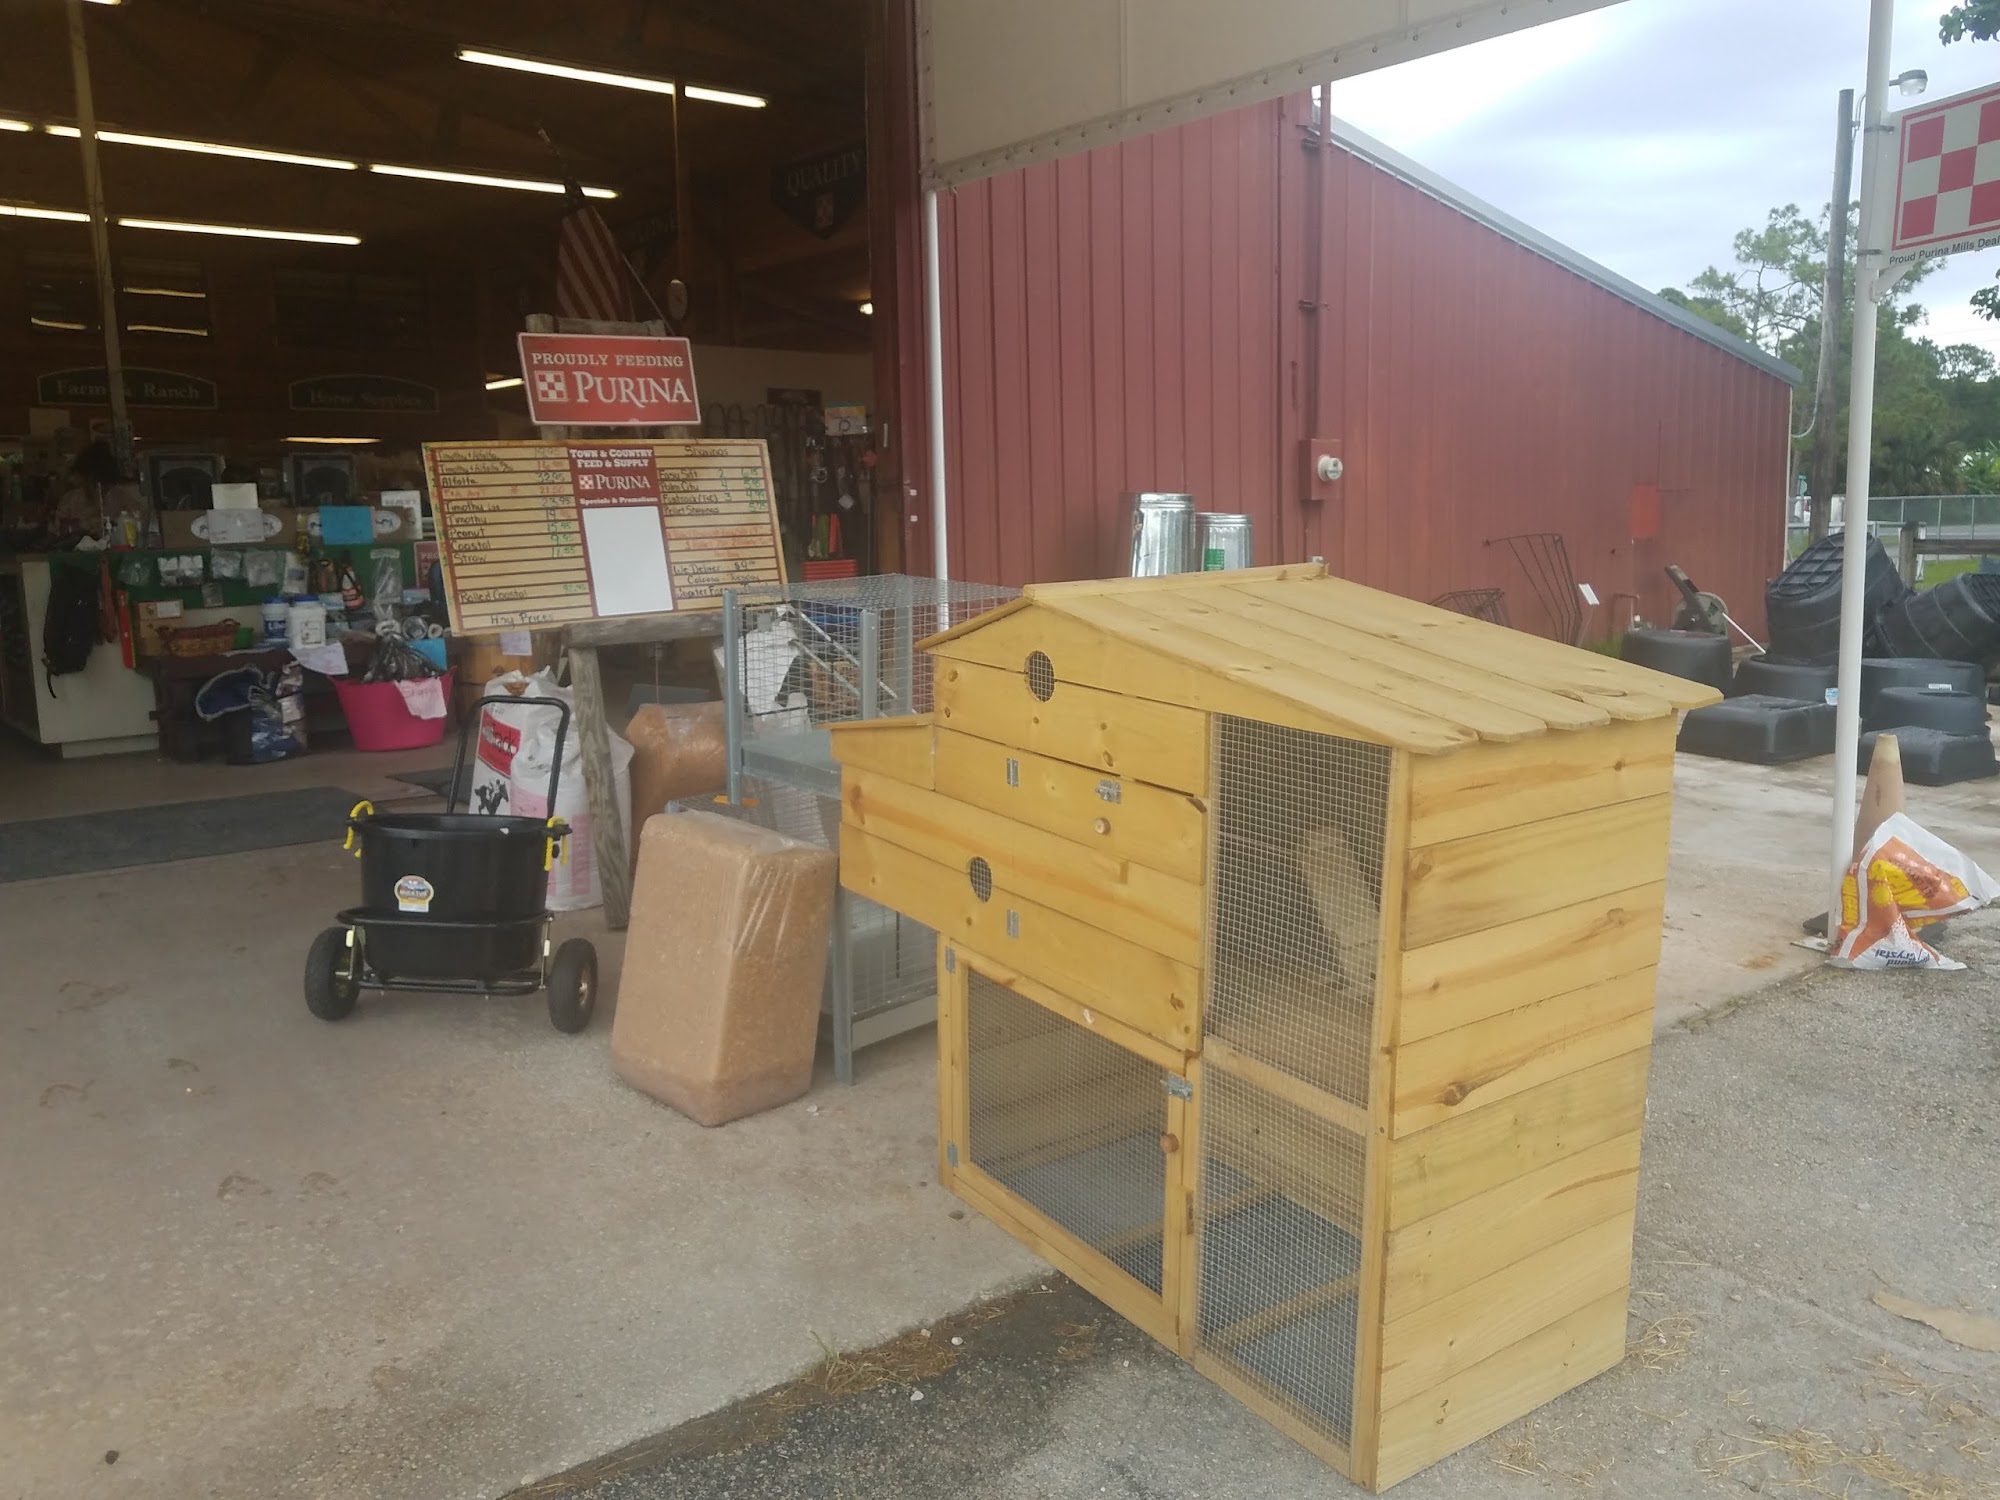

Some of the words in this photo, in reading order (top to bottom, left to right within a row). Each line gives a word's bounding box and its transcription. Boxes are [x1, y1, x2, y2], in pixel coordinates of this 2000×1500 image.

[1889, 252, 1916, 265] Proud
[1918, 247, 1949, 258] Purina
[1951, 241, 1975, 252] Mills
[532, 352, 609, 365] PROUDLY
[615, 355, 684, 367] FEEDING
[143, 382, 201, 398] Ranch
[572, 371, 693, 408] PURINA
[569, 449, 599, 458] TOWN
[600, 450, 607, 458] &
[608, 449, 654, 458] COUNTRY
[577, 459, 604, 468] FEED
[605, 459, 613, 467] &
[613, 458, 649, 468] SUPPLY
[594, 474, 652, 490] PURINA
[449, 527, 485, 538] Peanut
